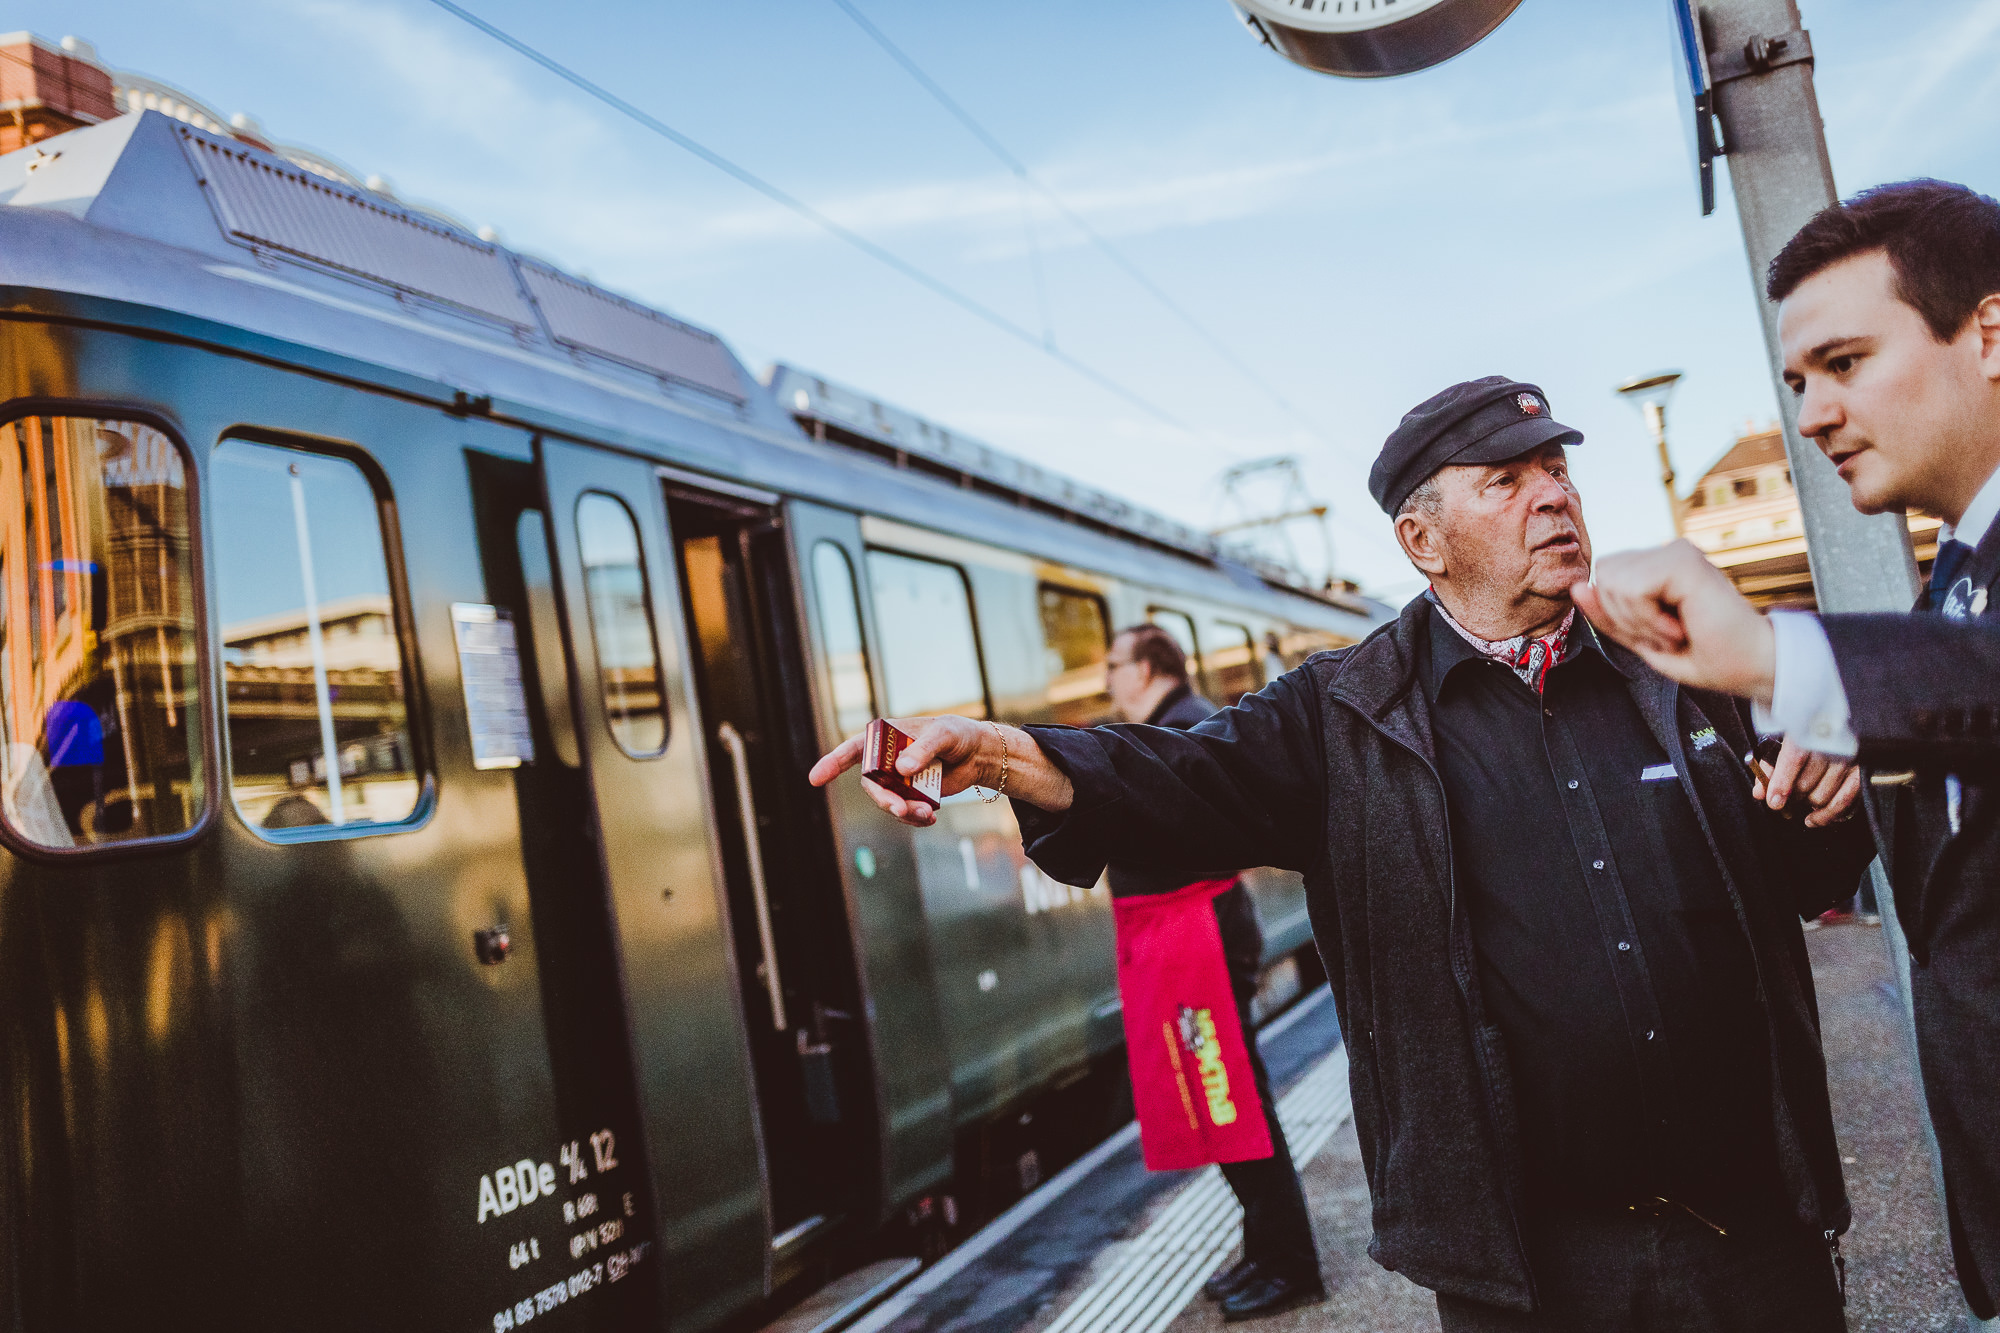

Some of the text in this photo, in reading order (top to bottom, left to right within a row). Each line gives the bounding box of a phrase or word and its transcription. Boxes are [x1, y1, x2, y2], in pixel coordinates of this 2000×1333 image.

[884, 726, 896, 772] MOODS
[477, 1158, 557, 1224] ABDe
[590, 1128, 619, 1174] 12
